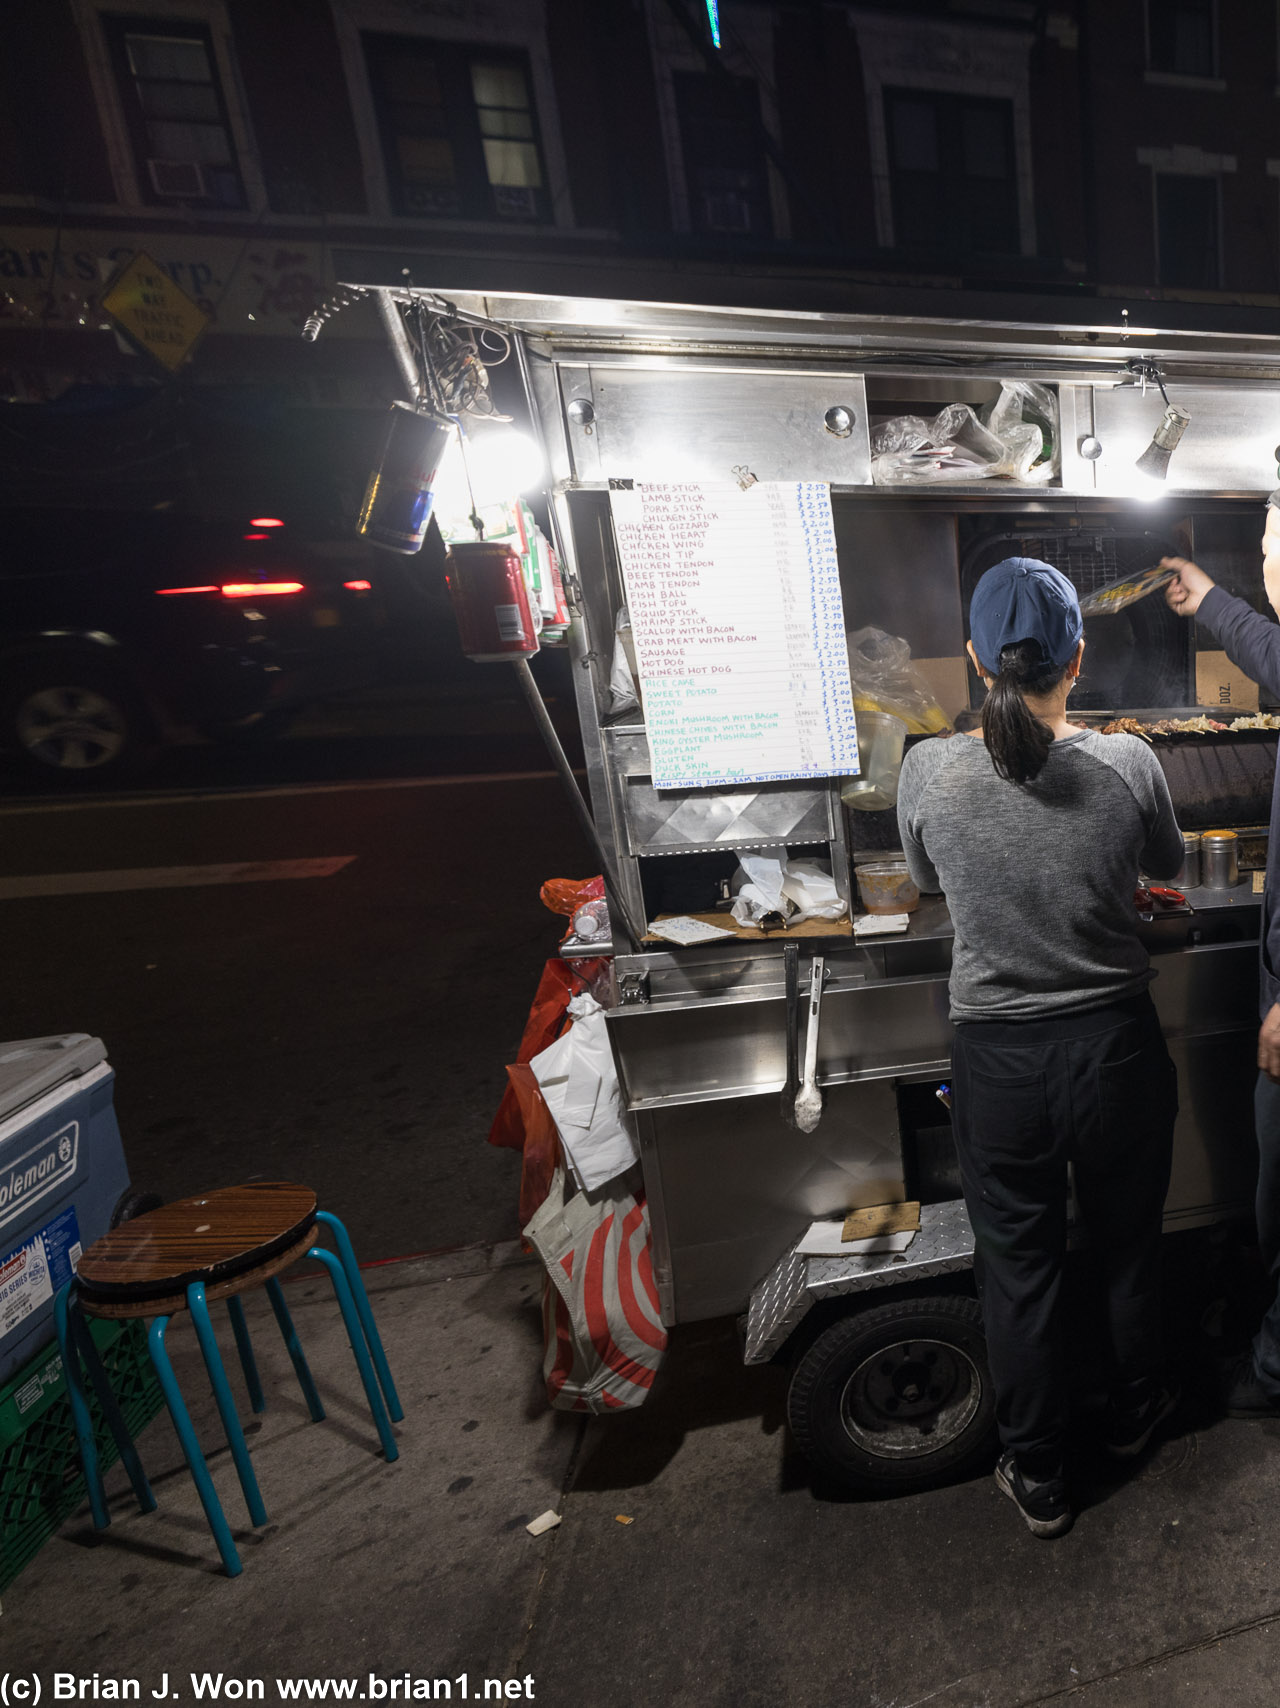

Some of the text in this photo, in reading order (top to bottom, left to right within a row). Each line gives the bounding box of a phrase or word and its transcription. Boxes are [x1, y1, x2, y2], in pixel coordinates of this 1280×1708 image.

[641, 483, 700, 493] BEEF STICK
[641, 494, 704, 503] LAMB STICK
[643, 504, 703, 512] PORK STICK
[643, 512, 718, 522] CHICKEN STICK
[618, 521, 710, 532] CHICKEN GIZZARD
[619, 530, 706, 541] CHICKEN HEART
[622, 540, 704, 551] CHICKEN WING
[623, 550, 694, 560] CHICKEN TIP
[624, 560, 714, 570] CHICKEN TENDON
[627, 570, 699, 580] BEEF TENDON
[628, 580, 700, 590] LAMB TENDON
[660, 590, 687, 599] BALL
[660, 599, 687, 607] TOFU
[633, 608, 698, 618] SQUID STICK
[634, 616, 708, 627] SHRIMP STICK
[636, 625, 735, 637] SCALLOP WITH BACON
[637, 635, 757, 647] CRAB MEAT WITH BACON
[640, 648, 686, 658] SAUSAGE
[641, 658, 684, 668] HOT DOG
[641, 665, 732, 679] CHINESE HOT DOG
[1219, 682, 1231, 704] DOZ.
